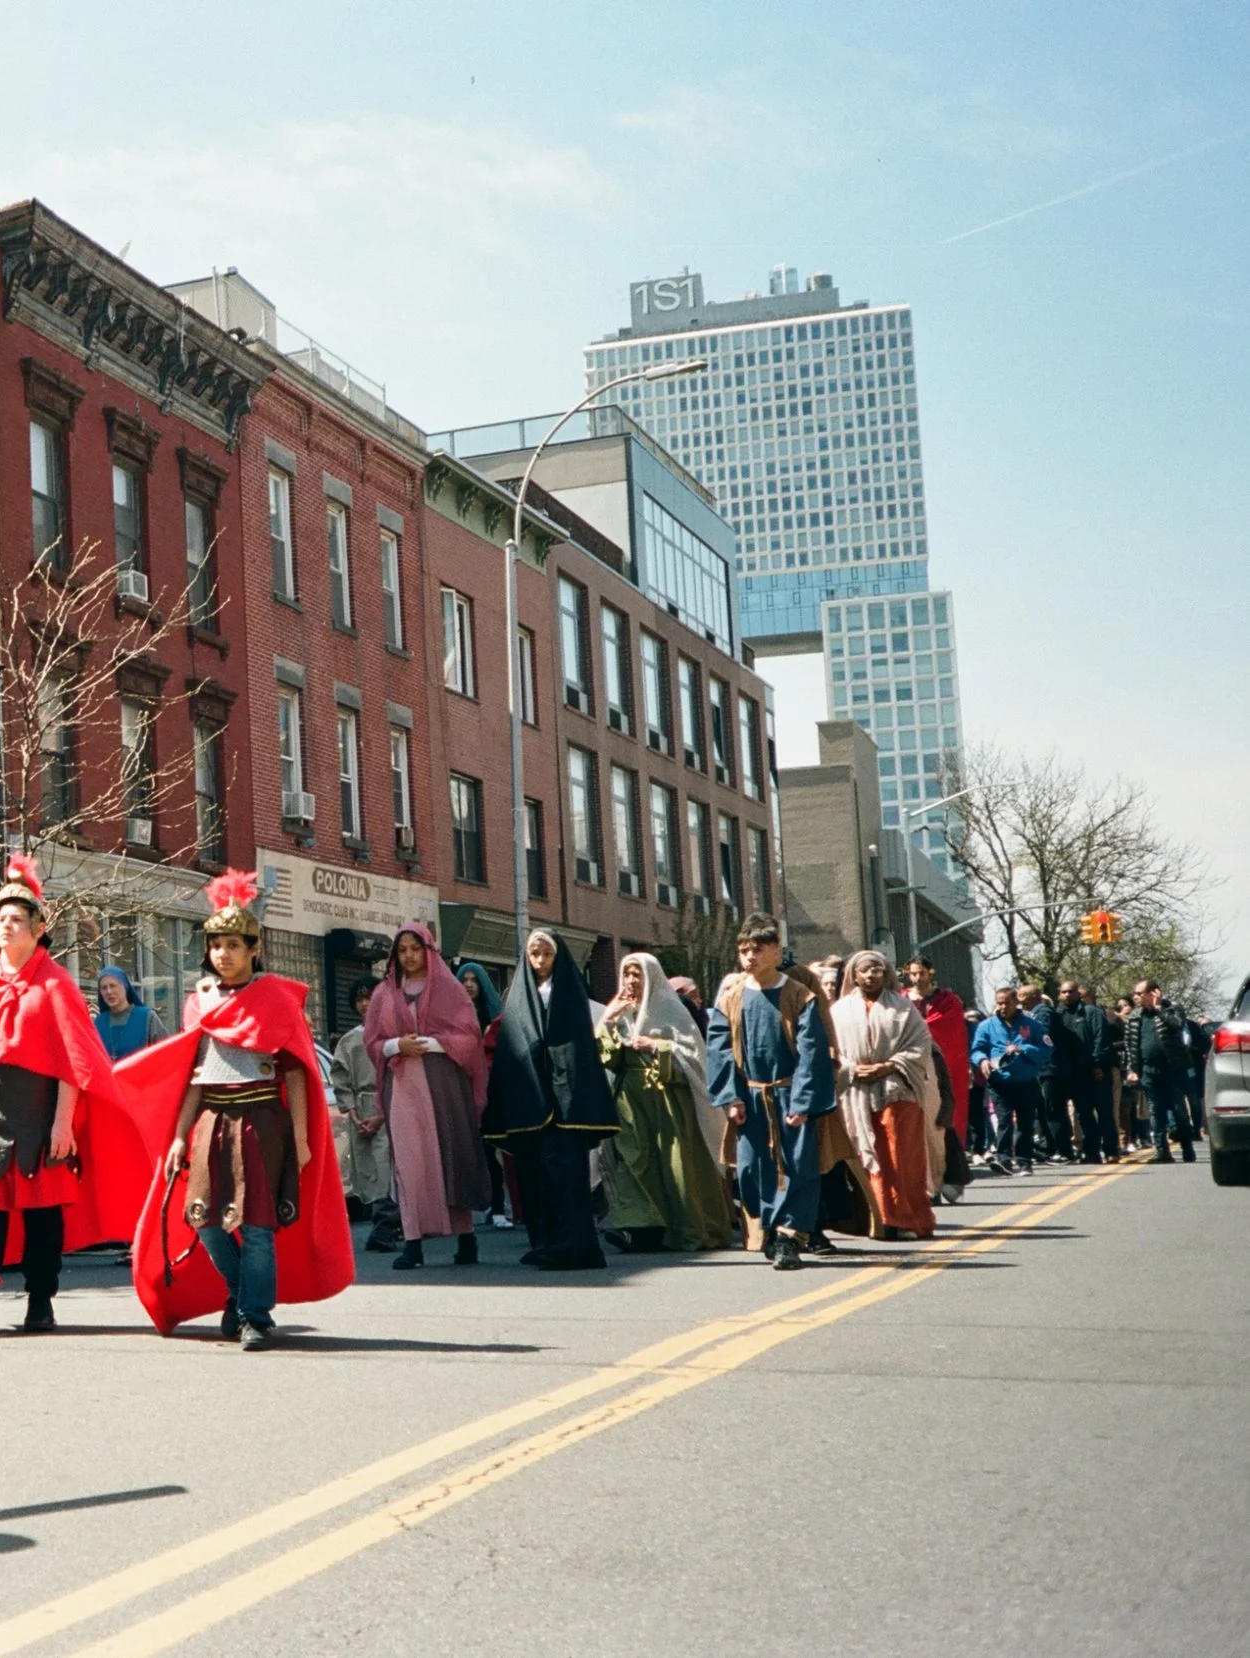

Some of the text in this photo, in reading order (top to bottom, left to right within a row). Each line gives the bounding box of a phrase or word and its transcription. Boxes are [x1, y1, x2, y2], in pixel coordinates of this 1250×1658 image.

[634, 277, 696, 314] 1S1
[315, 869, 368, 901] POLONIA
[333, 903, 349, 919] CLUB
